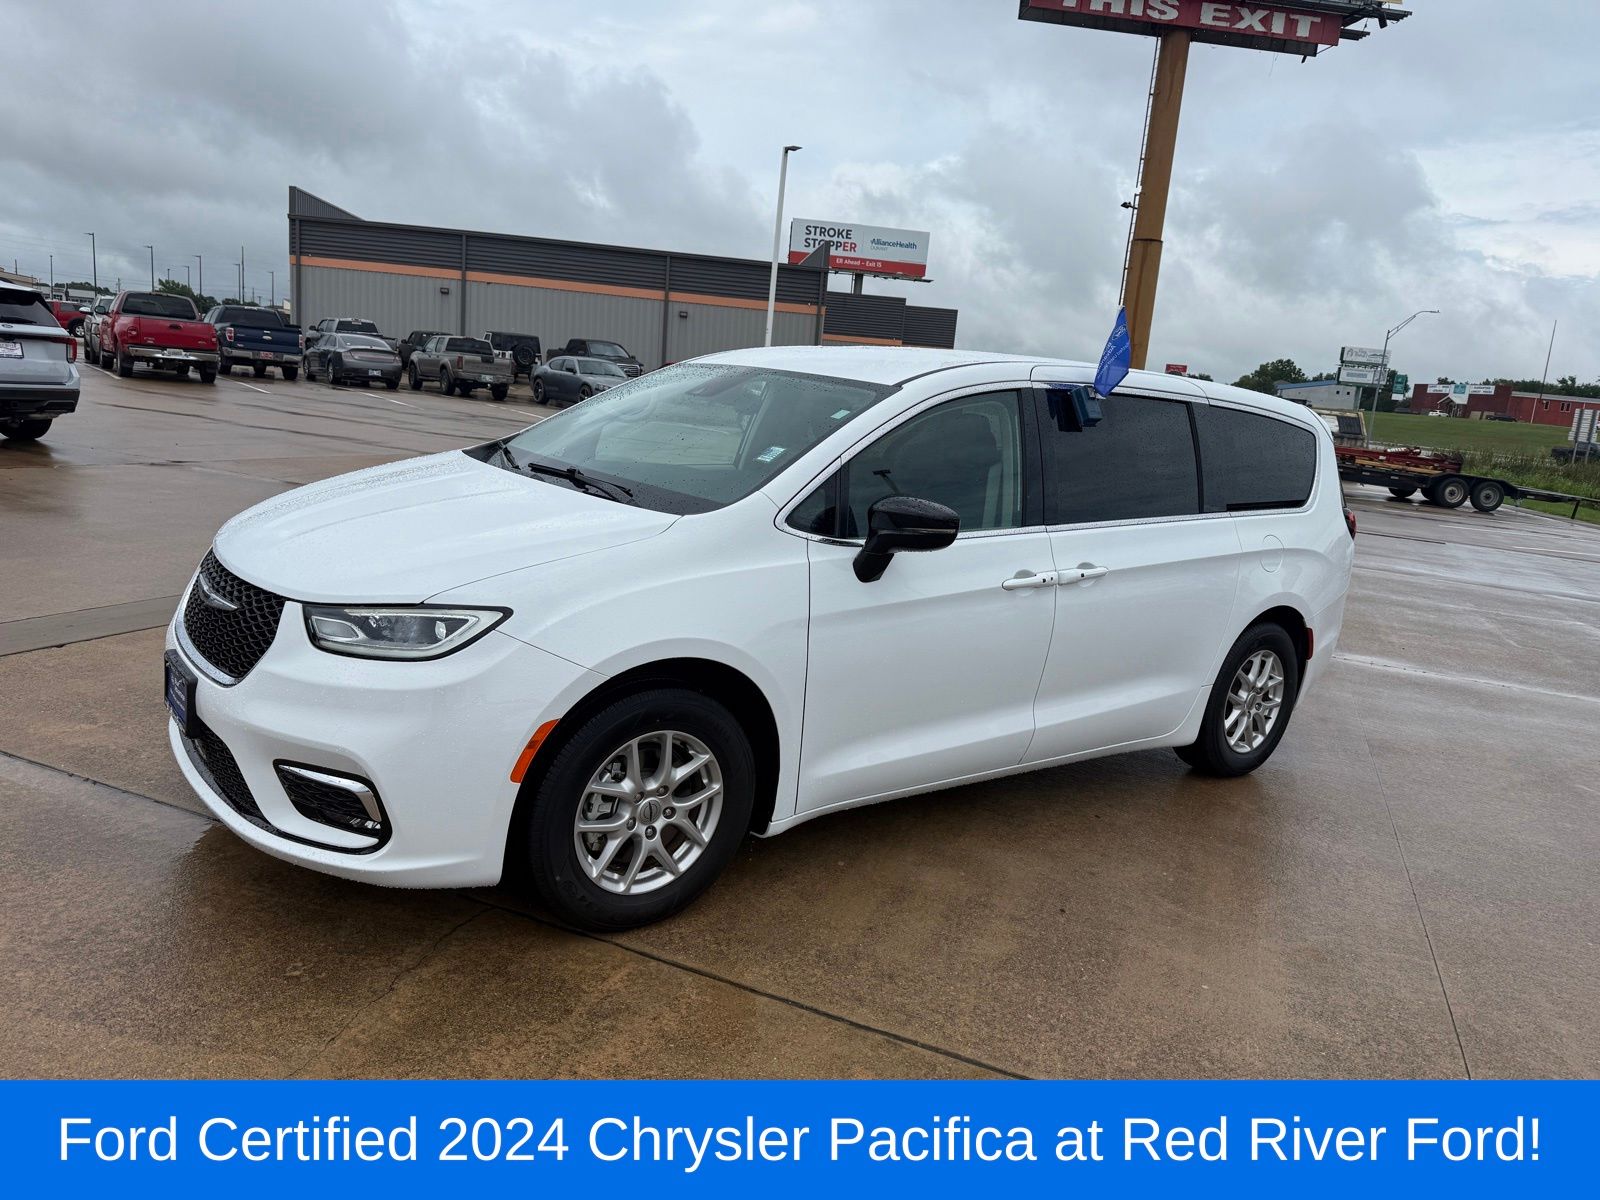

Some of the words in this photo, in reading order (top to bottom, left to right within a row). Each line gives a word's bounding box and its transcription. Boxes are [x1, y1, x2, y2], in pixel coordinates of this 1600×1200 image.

[1062, 0, 1180, 21] HIS
[1199, 2, 1322, 38] EXIT
[805, 224, 853, 240] STROKE
[870, 238, 917, 250] AllianceHealth
[844, 258, 860, 266] Ahead
